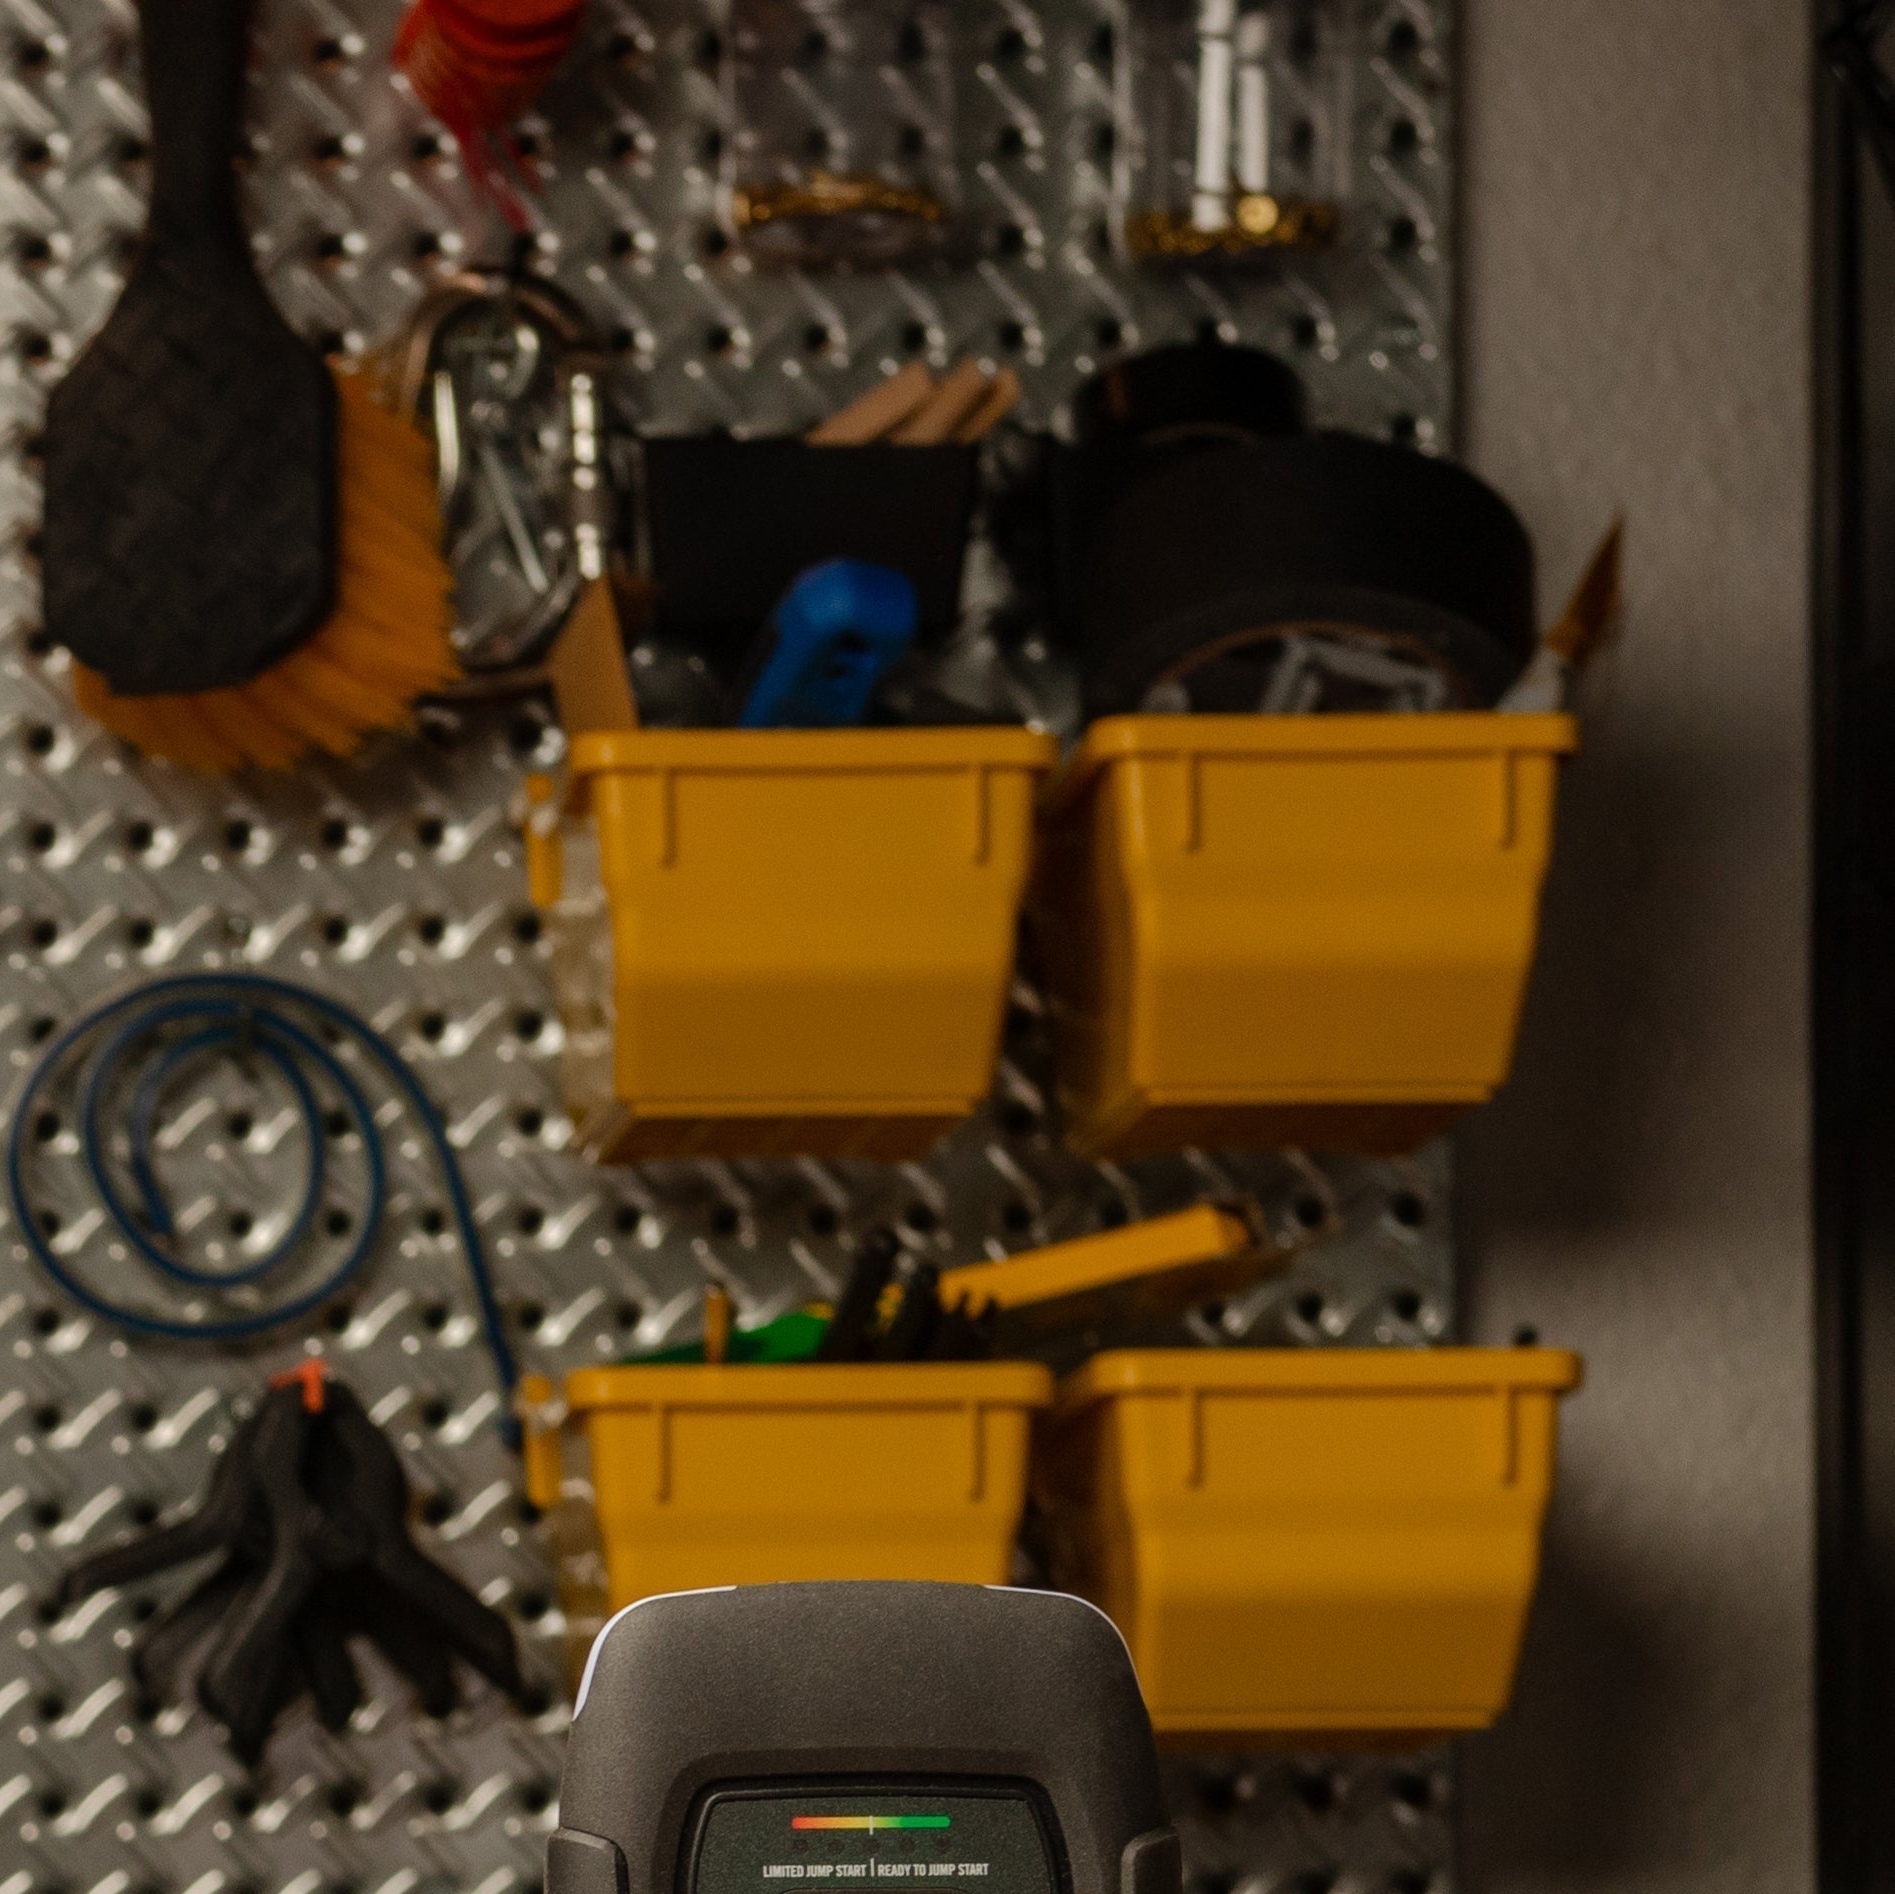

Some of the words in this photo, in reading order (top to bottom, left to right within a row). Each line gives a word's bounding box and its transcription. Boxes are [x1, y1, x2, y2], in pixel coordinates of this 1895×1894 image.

[763, 1865, 804, 1878] LIMITED
[806, 1865, 833, 1877] JUMP
[836, 1864, 866, 1877] START
[878, 1864, 911, 1876] READY
[914, 1864, 926, 1876] TO
[928, 1864, 955, 1876] JUMP
[958, 1863, 989, 1876] START
